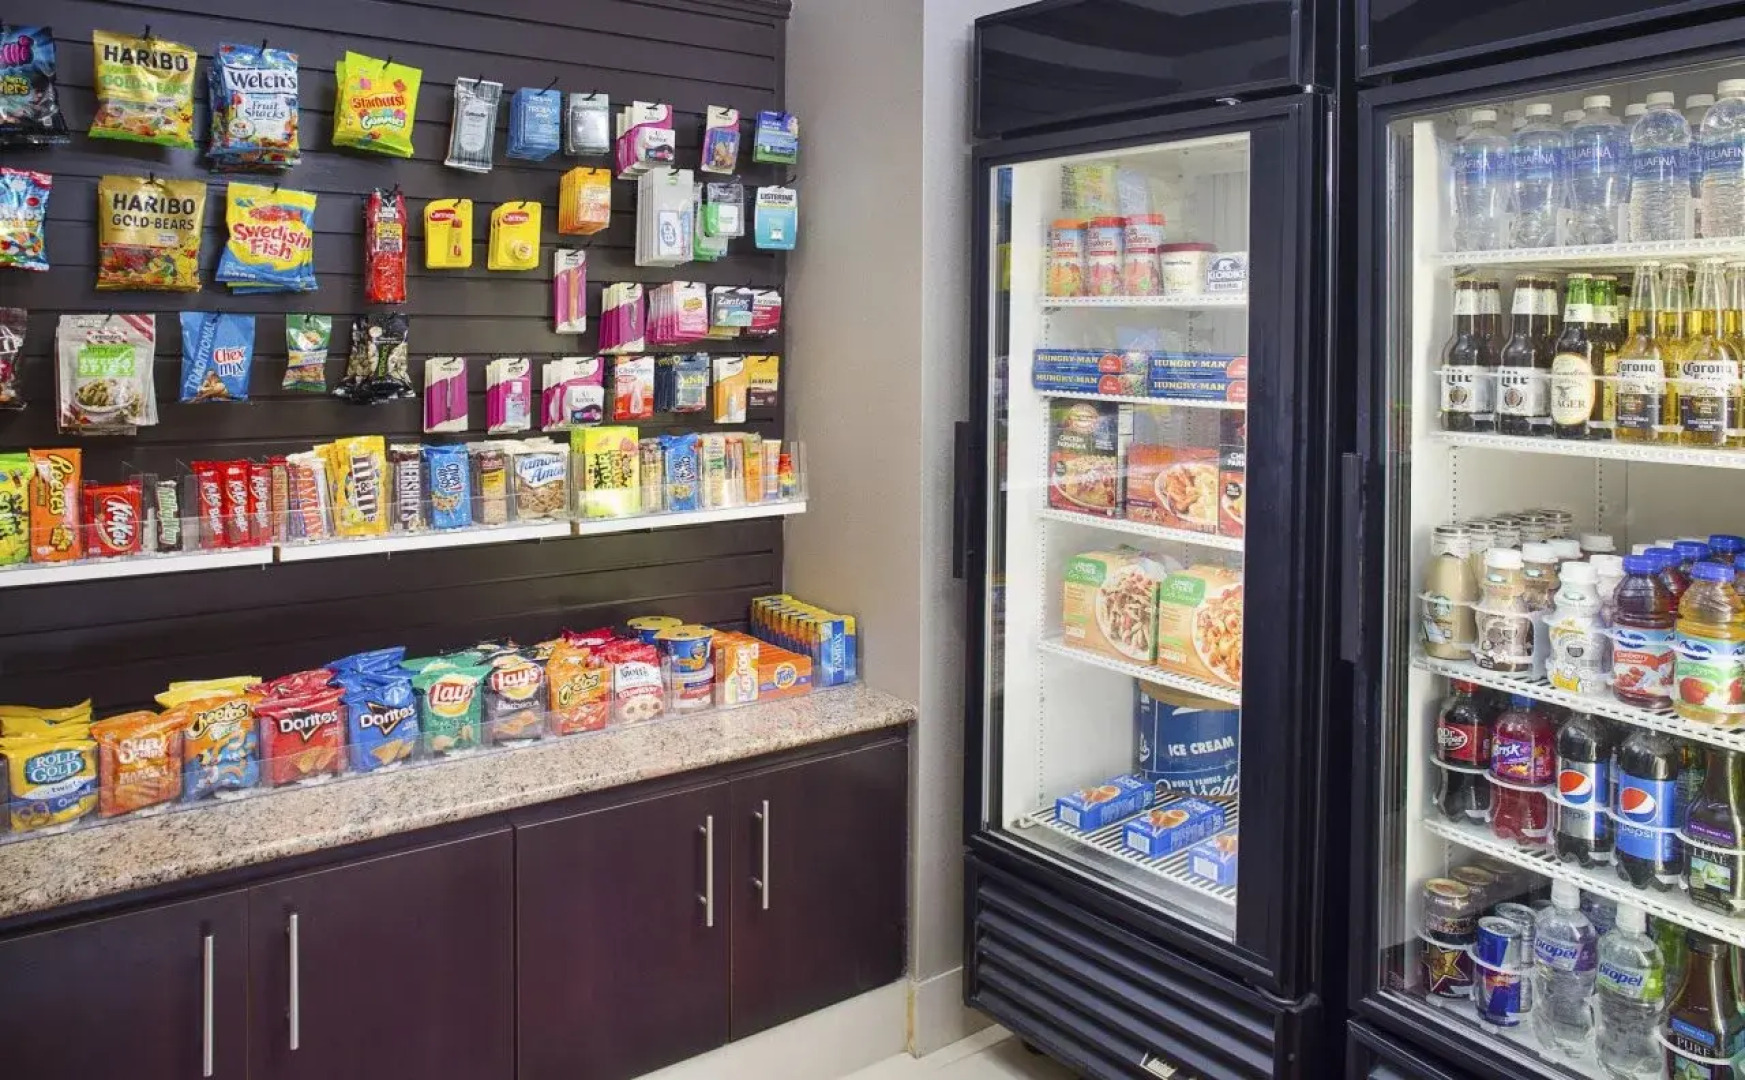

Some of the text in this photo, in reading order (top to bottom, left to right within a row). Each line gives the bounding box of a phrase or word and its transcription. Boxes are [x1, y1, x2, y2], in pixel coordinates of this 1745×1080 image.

[103, 44, 189, 72] HARIBO
[250, 99, 279, 111] Fruit
[352, 94, 406, 109] Starburst
[244, 106, 286, 120] Snacks
[112, 193, 197, 215] HARIBO
[111, 212, 195, 231] GOLD-BEARS
[232, 222, 313, 250] Swedish
[250, 238, 294, 262] Fish
[186, 319, 217, 391] TRADITIONAL
[213, 347, 245, 364] Chex
[1037, 354, 1099, 364] HUNGRY-MAN
[1154, 359, 1227, 369] HUNGRY-MAN
[218, 361, 245, 377] mix
[1036, 373, 1097, 384] HUNGRY-MAN
[1154, 381, 1226, 391] HUNGRY-MAN
[832, 632, 845, 674] TAMPAX
[776, 667, 797, 685] Tide
[188, 701, 249, 739] Cheetos
[280, 710, 338, 734] Doritos
[360, 704, 415, 730] Doritos
[1168, 735, 1235, 757] ICE CREAM
[36, 748, 79, 768] ROLD
[30, 756, 82, 783] GOLD
[1535, 937, 1577, 960] propel
[1600, 962, 1644, 987] propel
[1677, 1036, 1711, 1057] PURE
